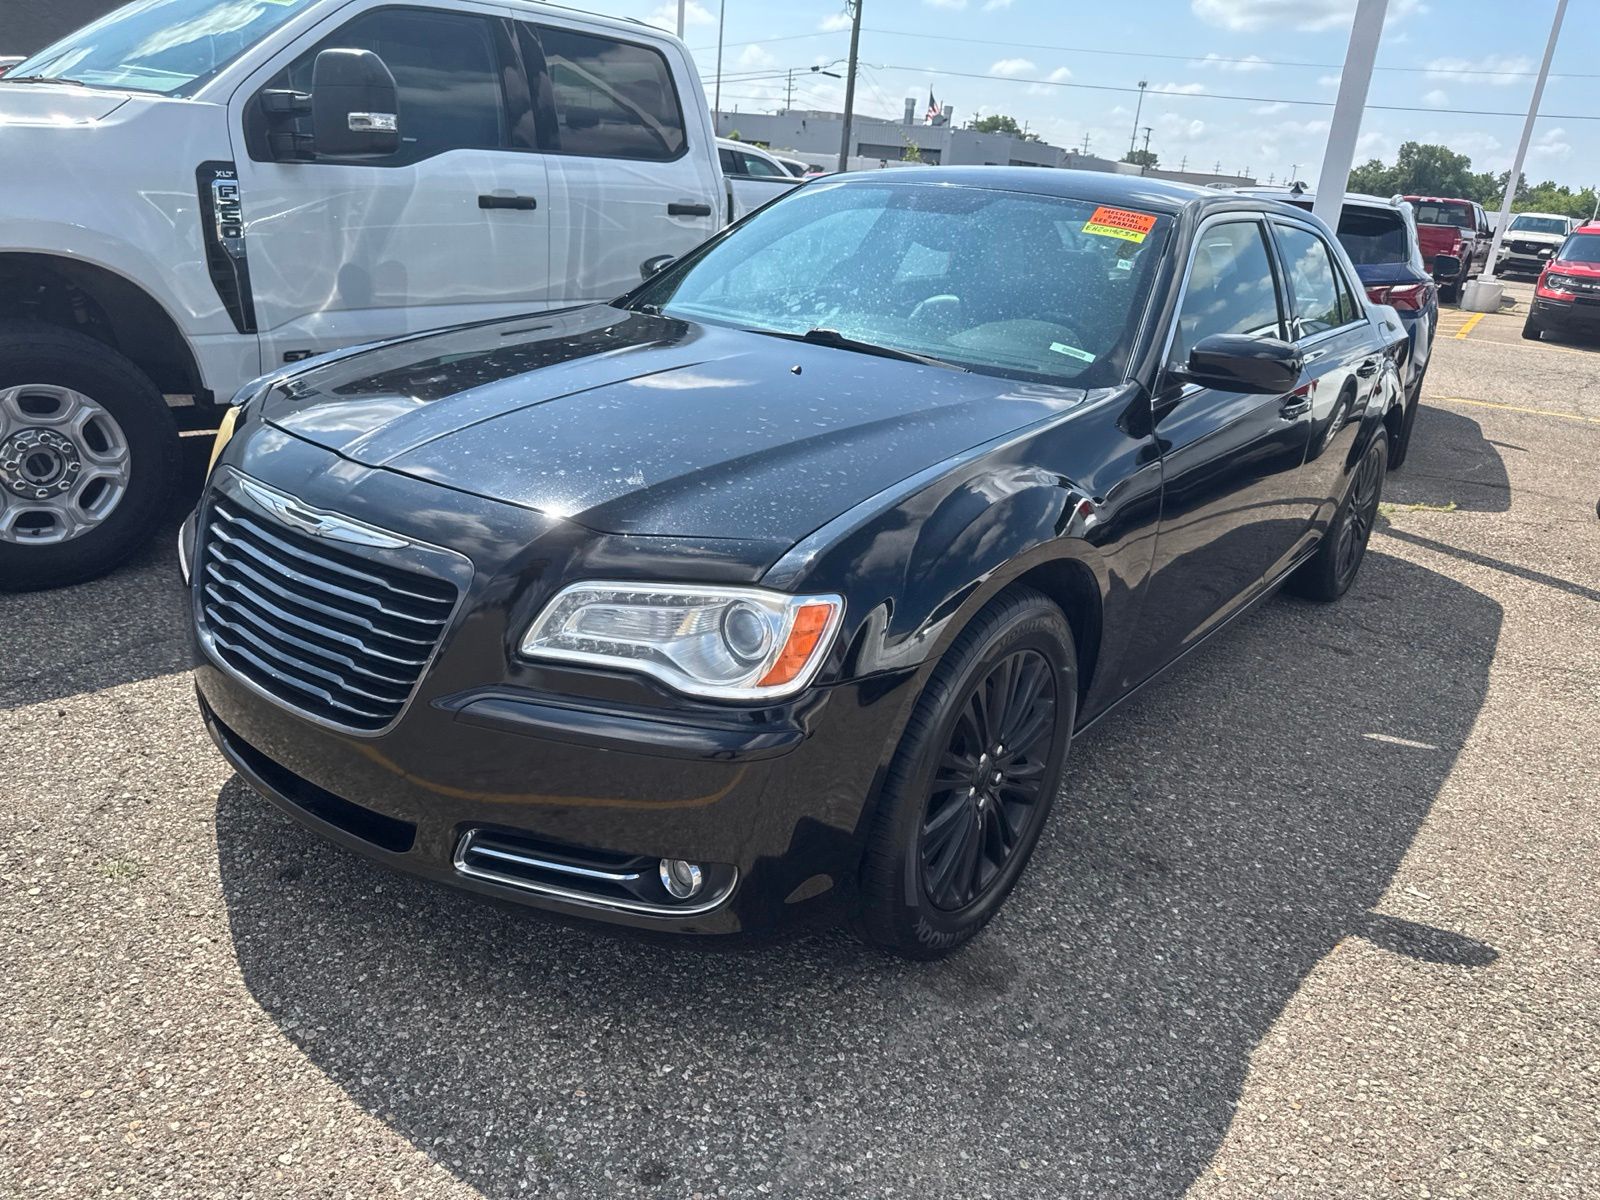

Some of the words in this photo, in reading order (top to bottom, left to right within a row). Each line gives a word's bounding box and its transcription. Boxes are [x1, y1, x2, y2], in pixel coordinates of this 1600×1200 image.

[215, 170, 234, 178] XLT
[1108, 214, 1139, 224] SPECIAL
[1108, 220, 1149, 231] MANAGER
